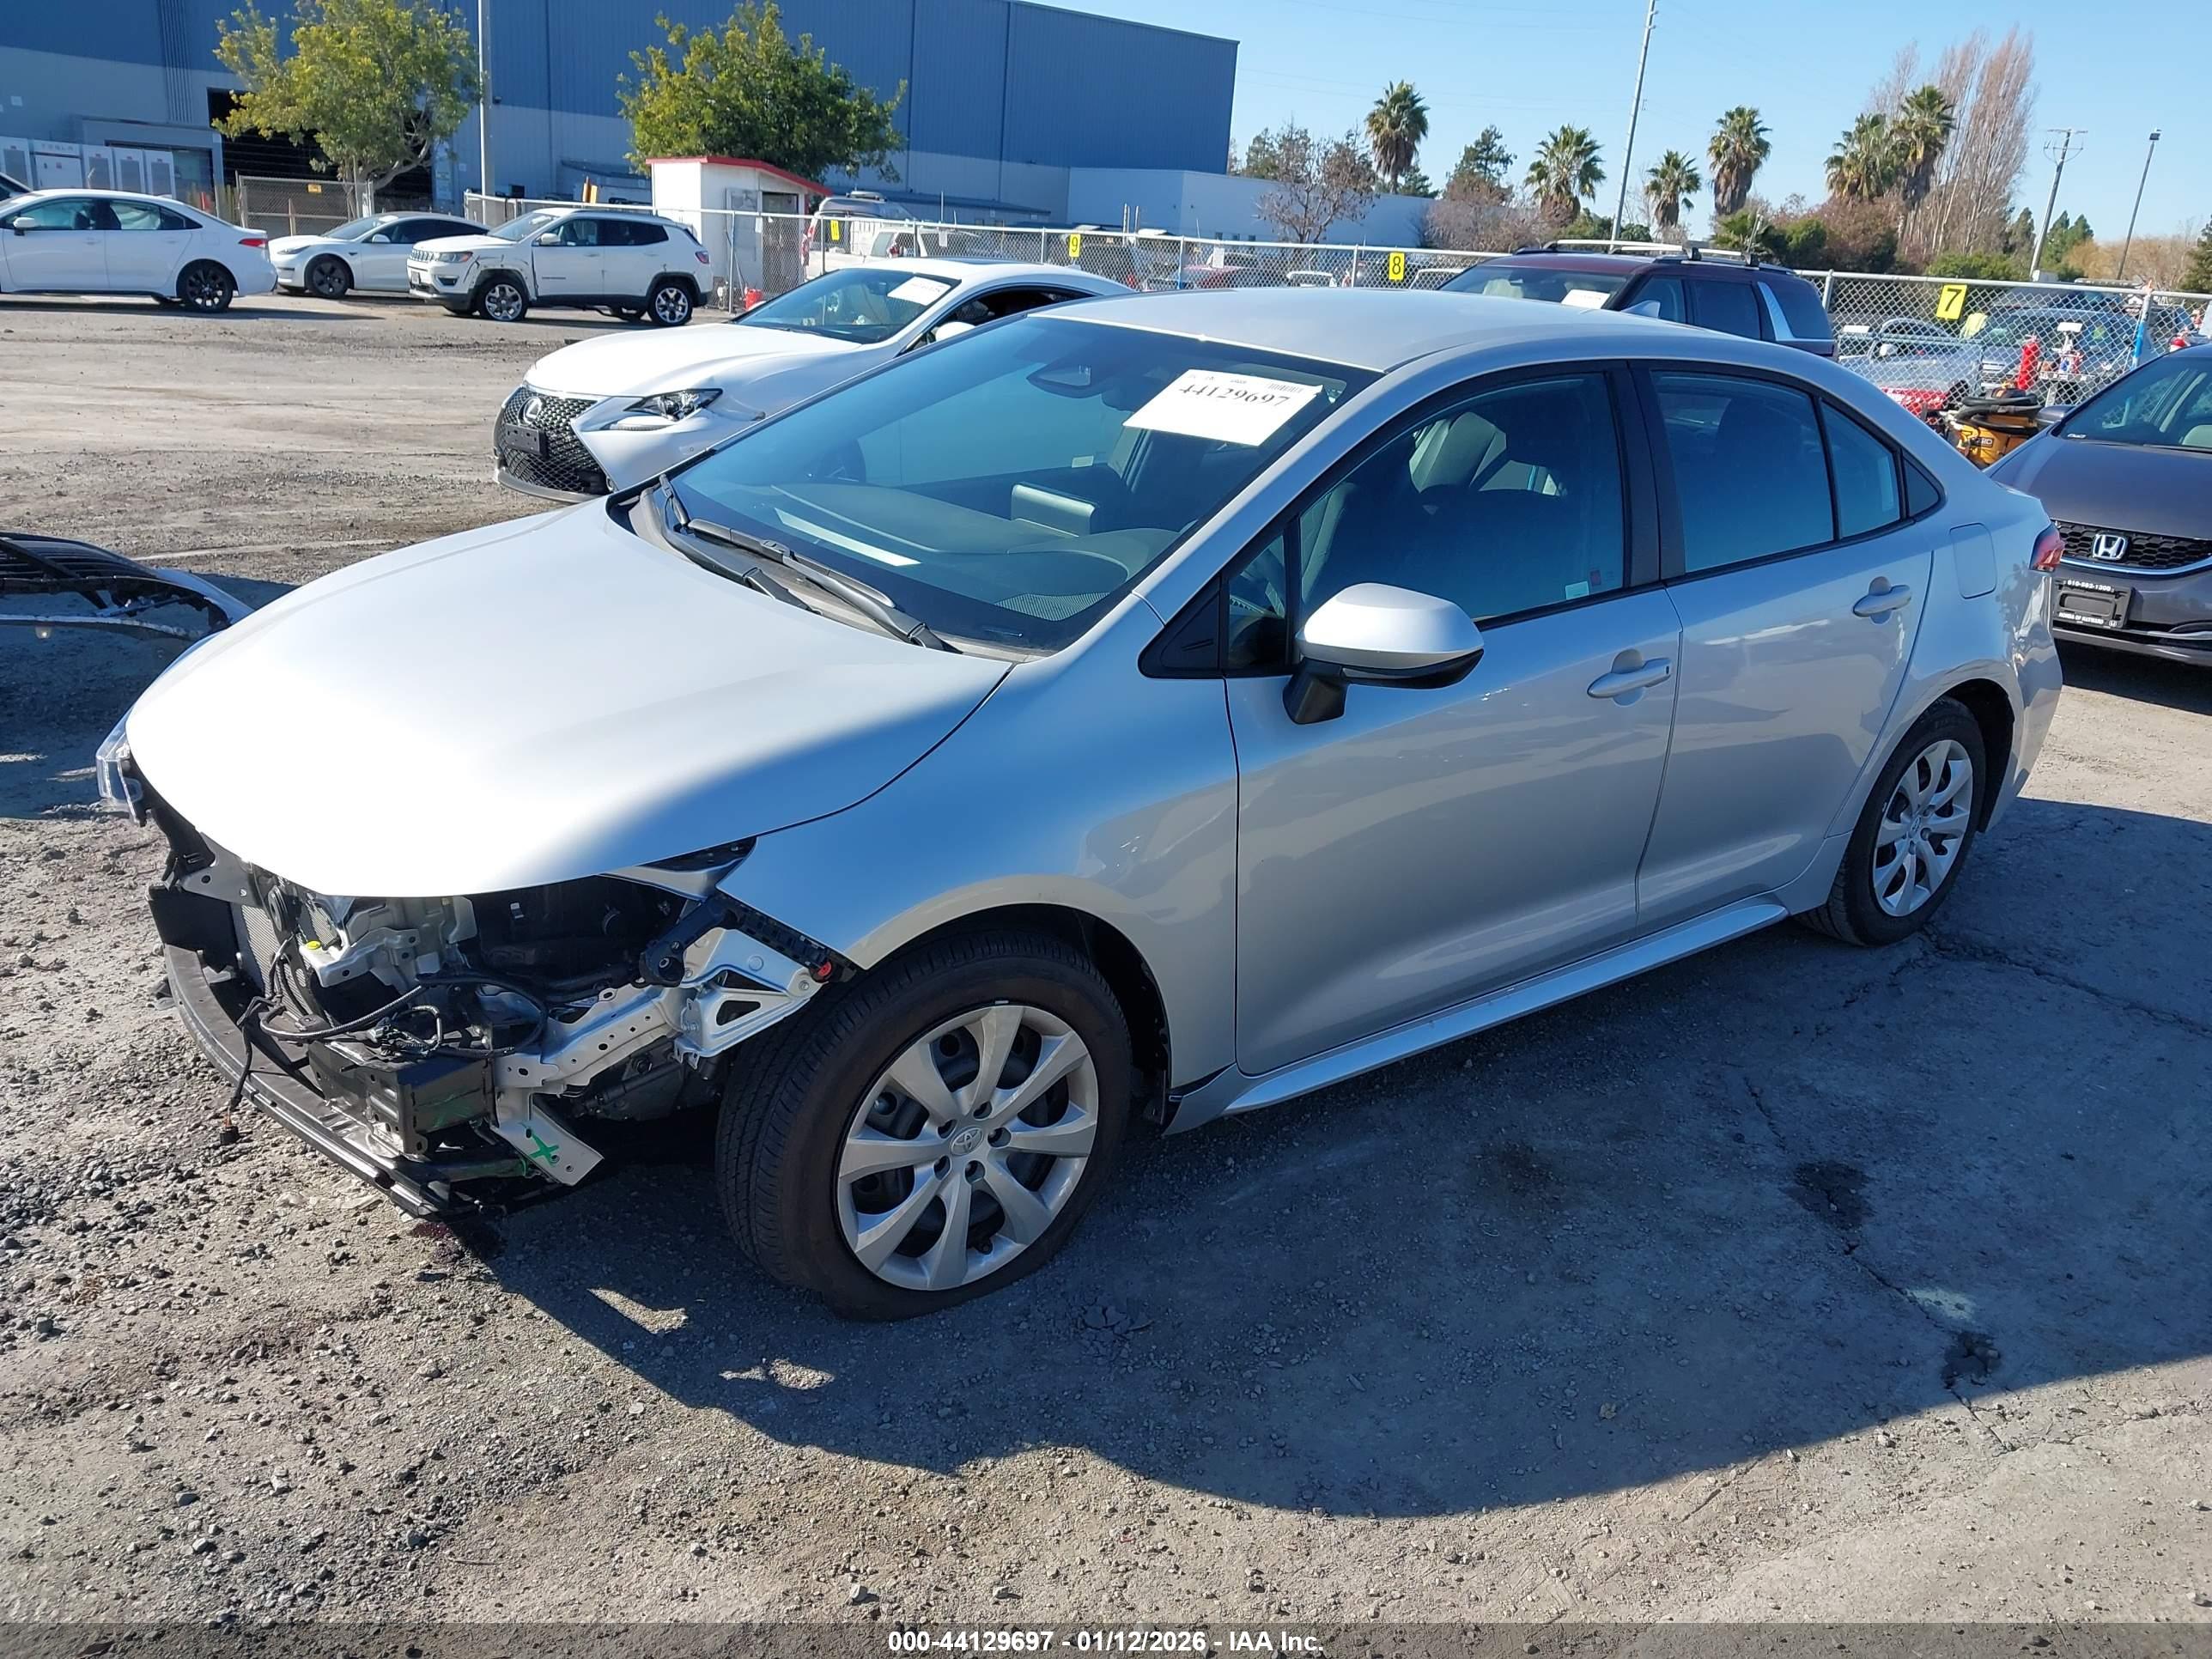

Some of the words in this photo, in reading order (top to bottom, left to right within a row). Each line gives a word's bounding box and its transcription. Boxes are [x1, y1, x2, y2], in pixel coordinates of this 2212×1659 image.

[1071, 236, 1079, 252] 9
[1392, 256, 1401, 275] 8
[1944, 288, 1963, 312] 7
[1178, 384, 1291, 407] 44129697
